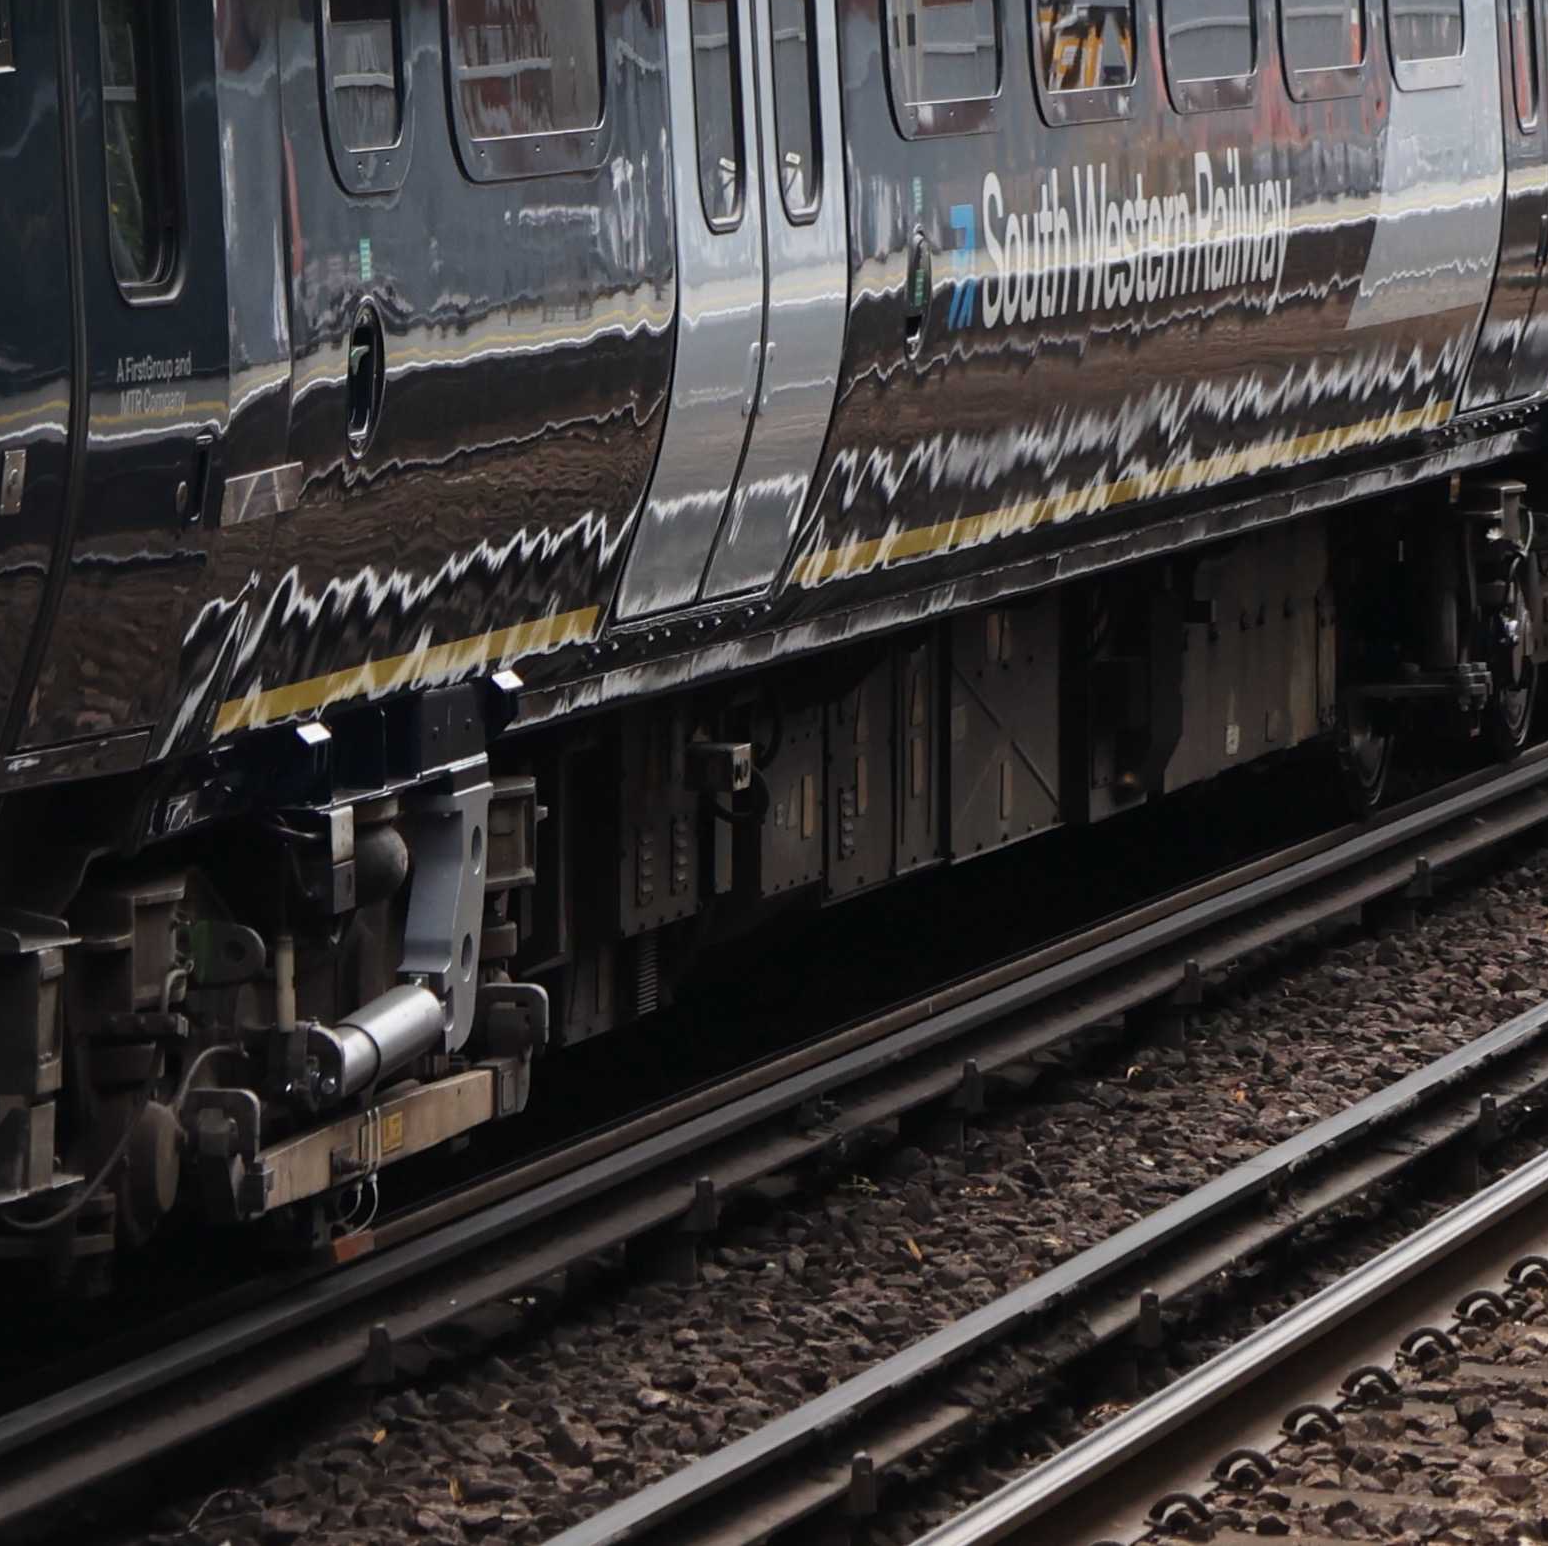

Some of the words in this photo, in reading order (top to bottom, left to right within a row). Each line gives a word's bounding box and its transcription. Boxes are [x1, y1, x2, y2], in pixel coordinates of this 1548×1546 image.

[981, 167, 1071, 329] South
[1072, 162, 1191, 313] Western
[1193, 146, 1292, 316] Railway
[116, 357, 125, 383] A
[125, 354, 173, 384] FirstGroup
[173, 350, 192, 377] and
[120, 388, 143, 415] MTR
